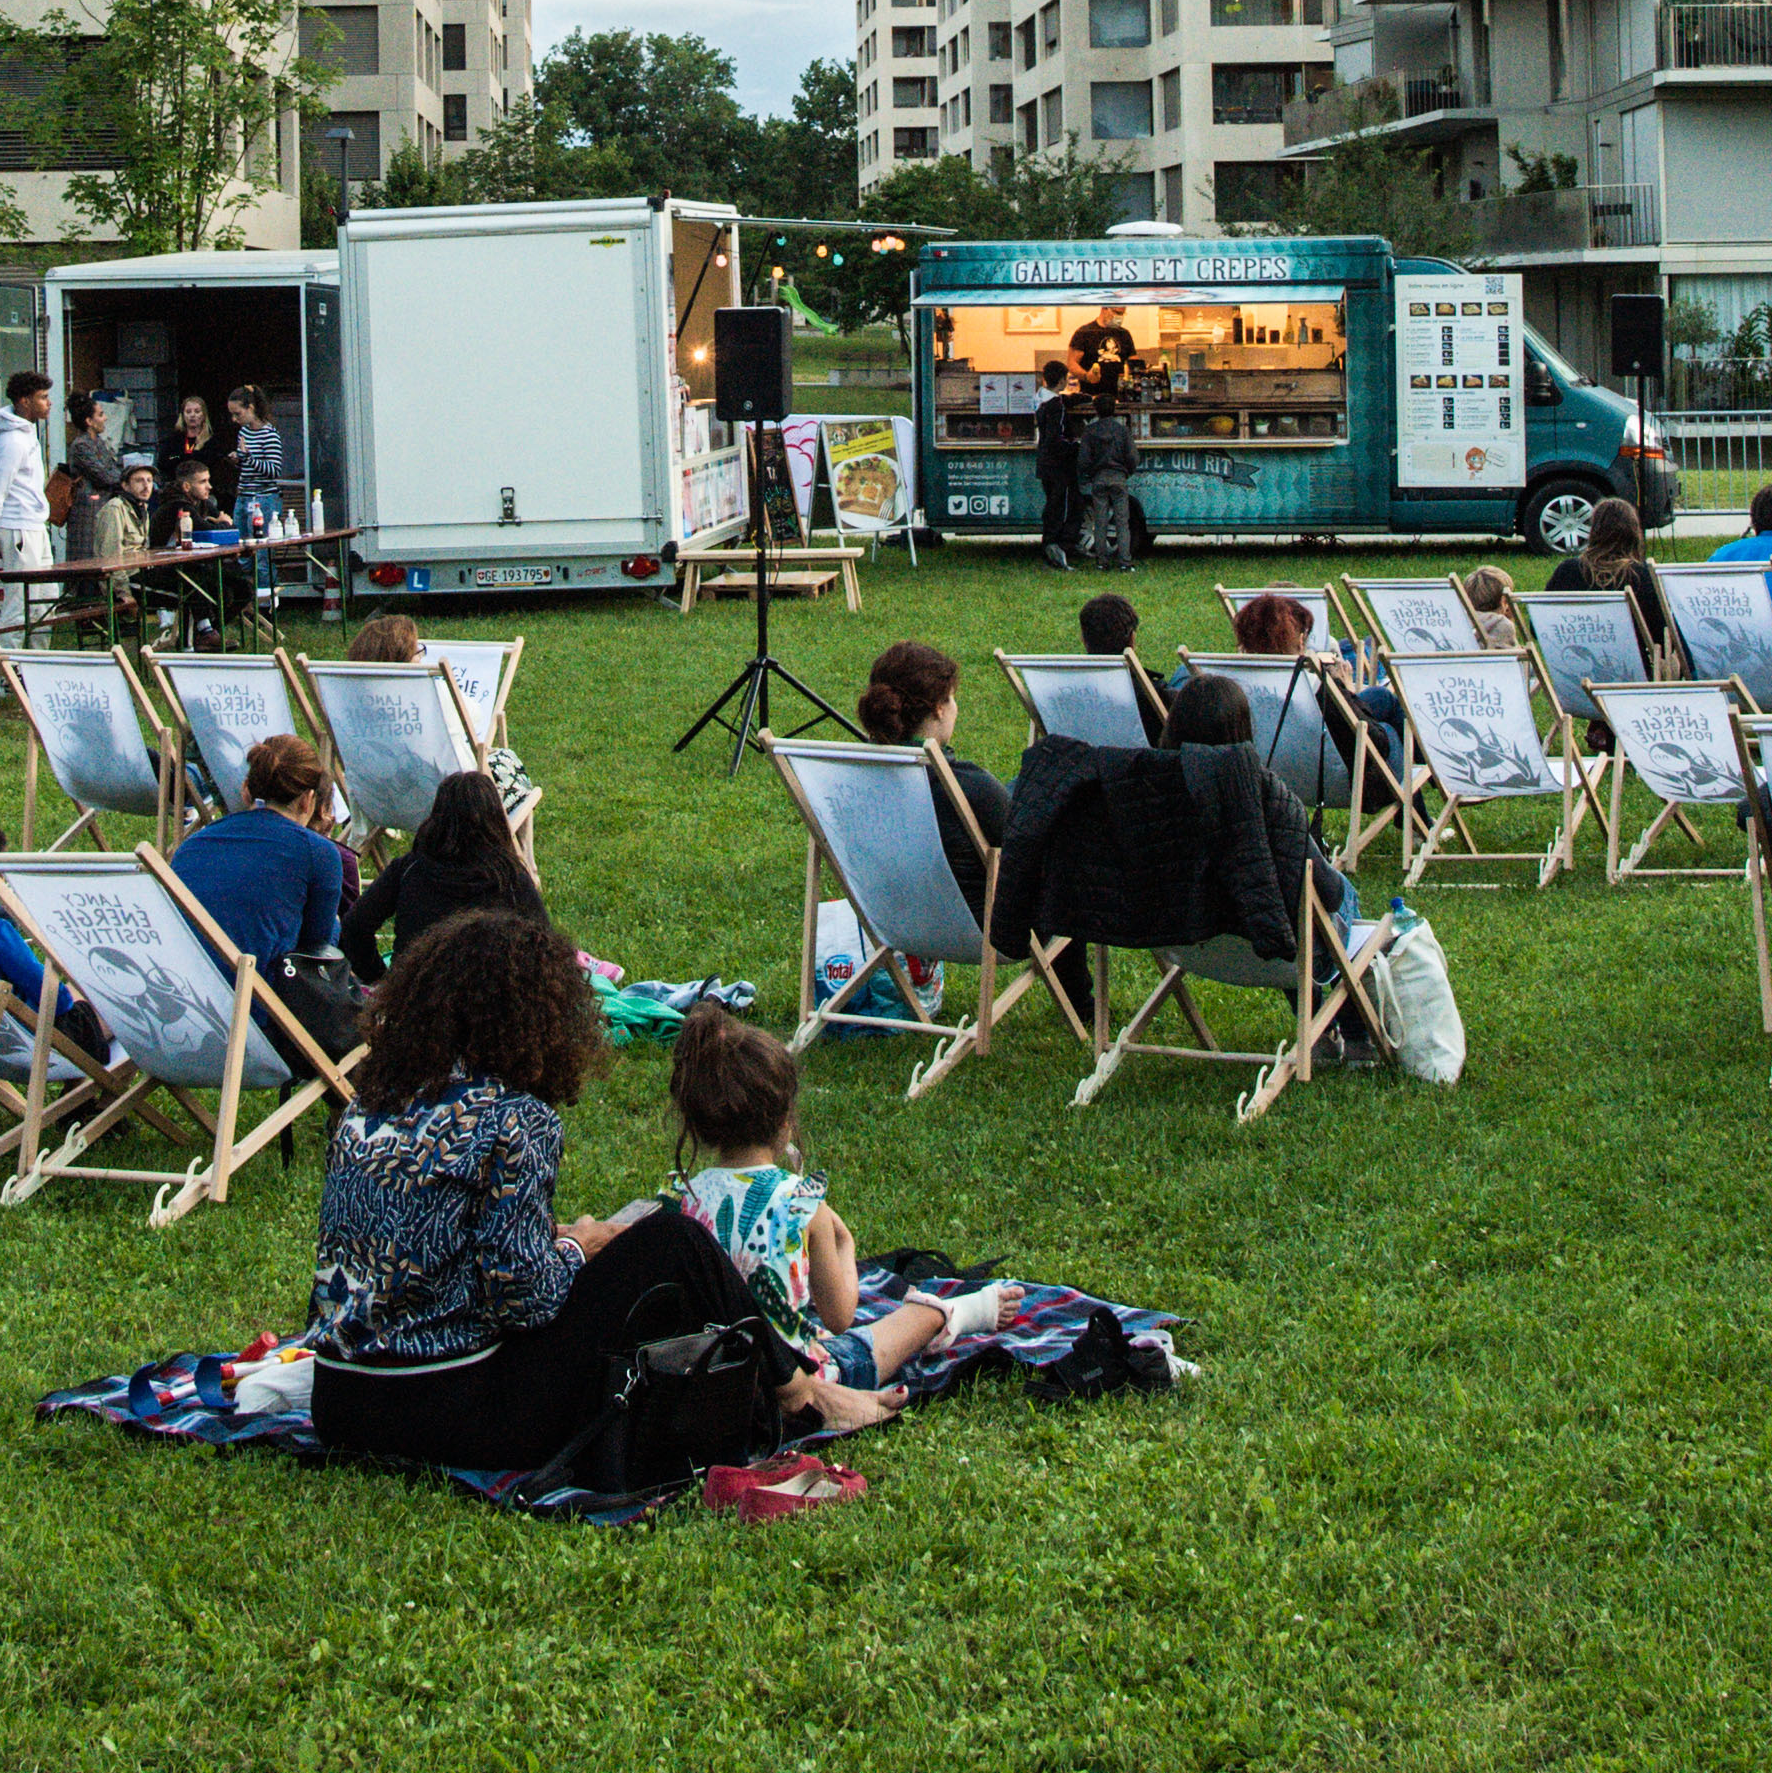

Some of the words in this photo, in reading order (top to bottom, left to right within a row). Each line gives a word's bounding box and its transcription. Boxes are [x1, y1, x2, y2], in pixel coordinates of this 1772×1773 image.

[1015, 259, 1138, 283] GALETTES
[1152, 258, 1183, 280] ET
[1197, 256, 1288, 280] CREPES
[1171, 452, 1197, 470] QUI
[1205, 454, 1233, 476] RIT
[413, 572, 423, 588] L
[485, 571, 497, 582] GE
[503, 569, 543, 581] 193795
[826, 961, 854, 981] Total
